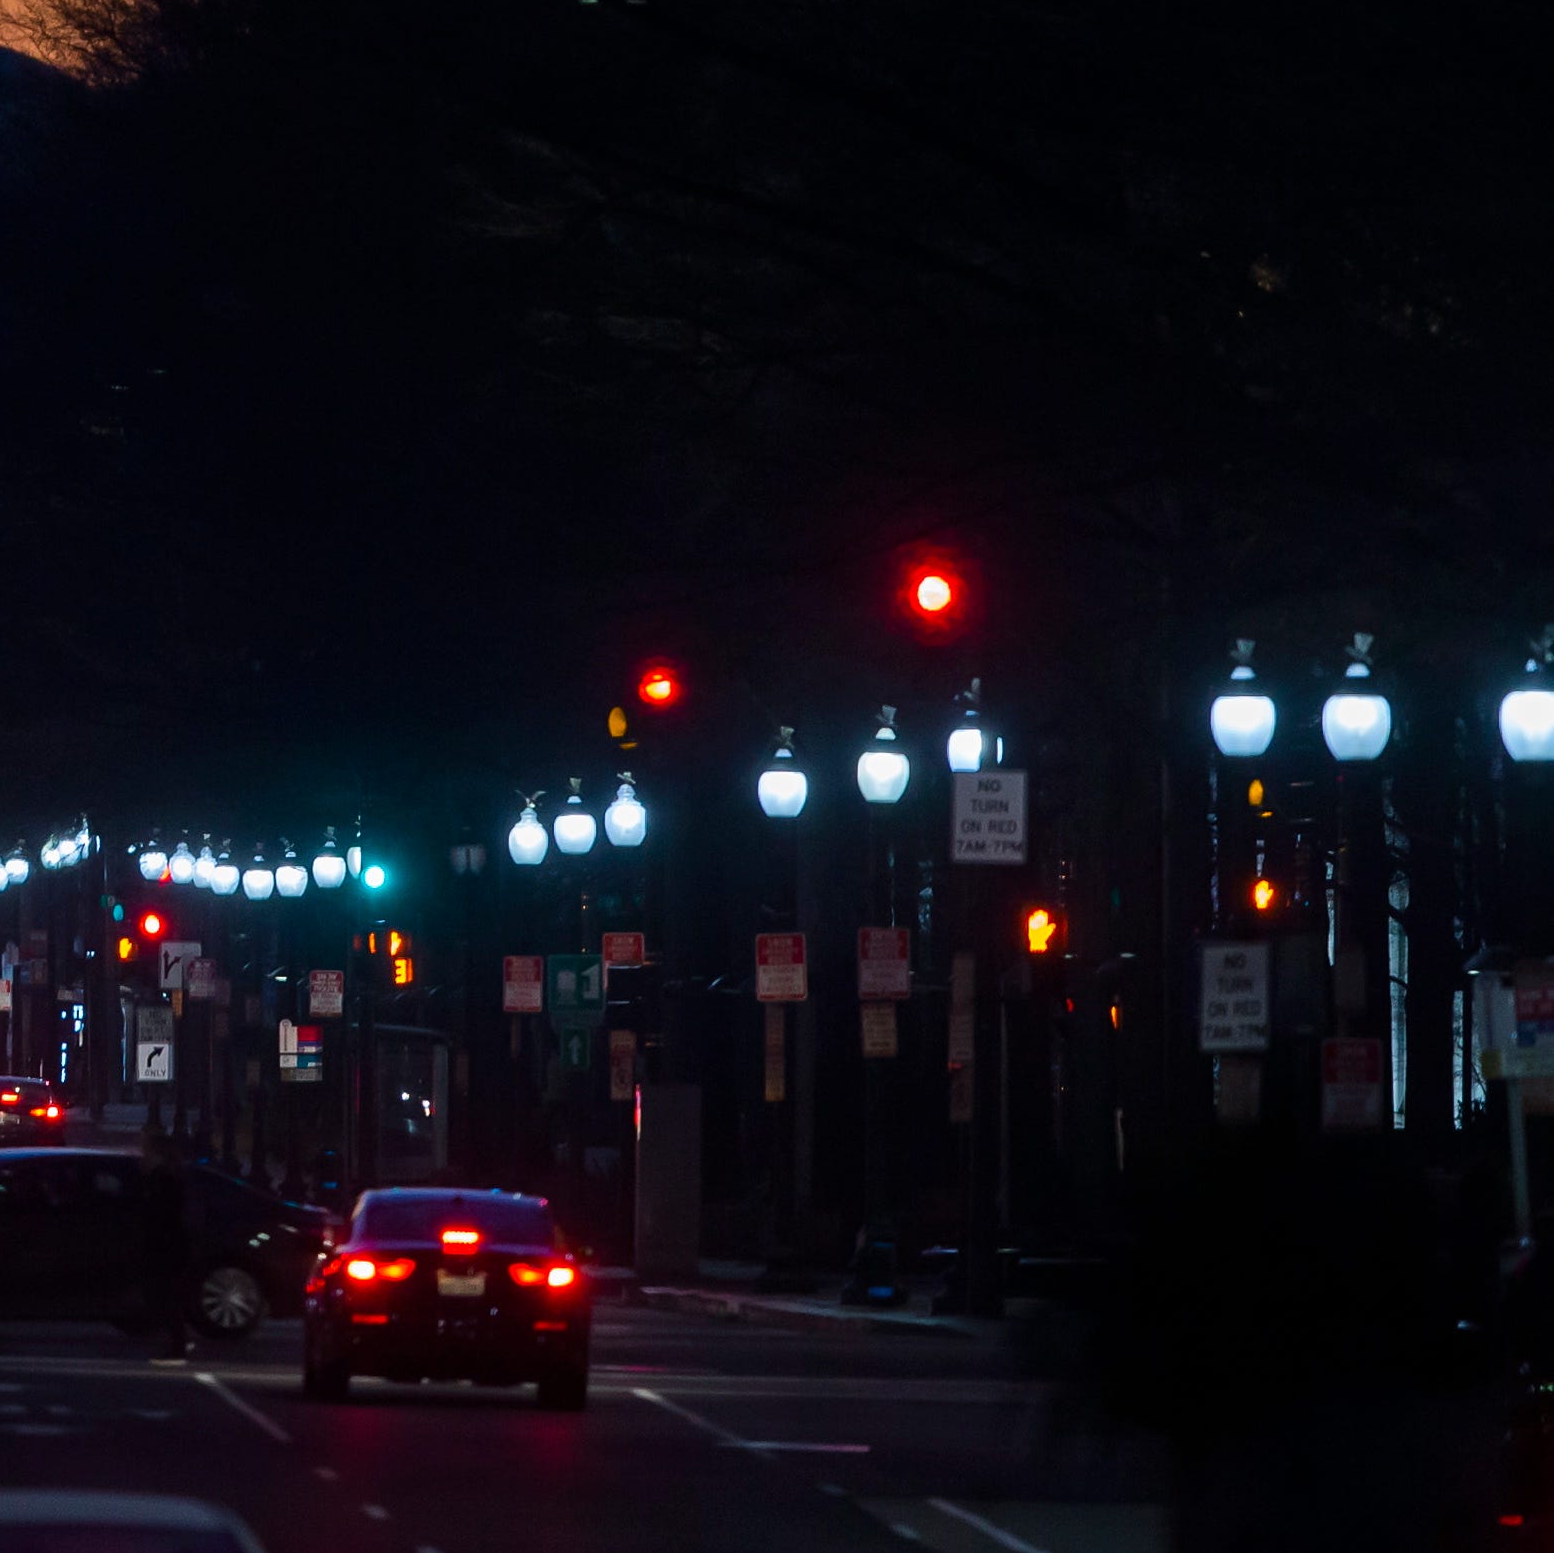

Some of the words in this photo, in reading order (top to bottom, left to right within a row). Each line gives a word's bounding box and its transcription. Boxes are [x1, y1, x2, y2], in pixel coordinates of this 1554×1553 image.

[977, 779, 1001, 793] NO
[970, 798, 1009, 814] TURN
[960, 819, 982, 833] ON
[987, 819, 1017, 834] RED
[144, 1069, 167, 1078] ONLY
